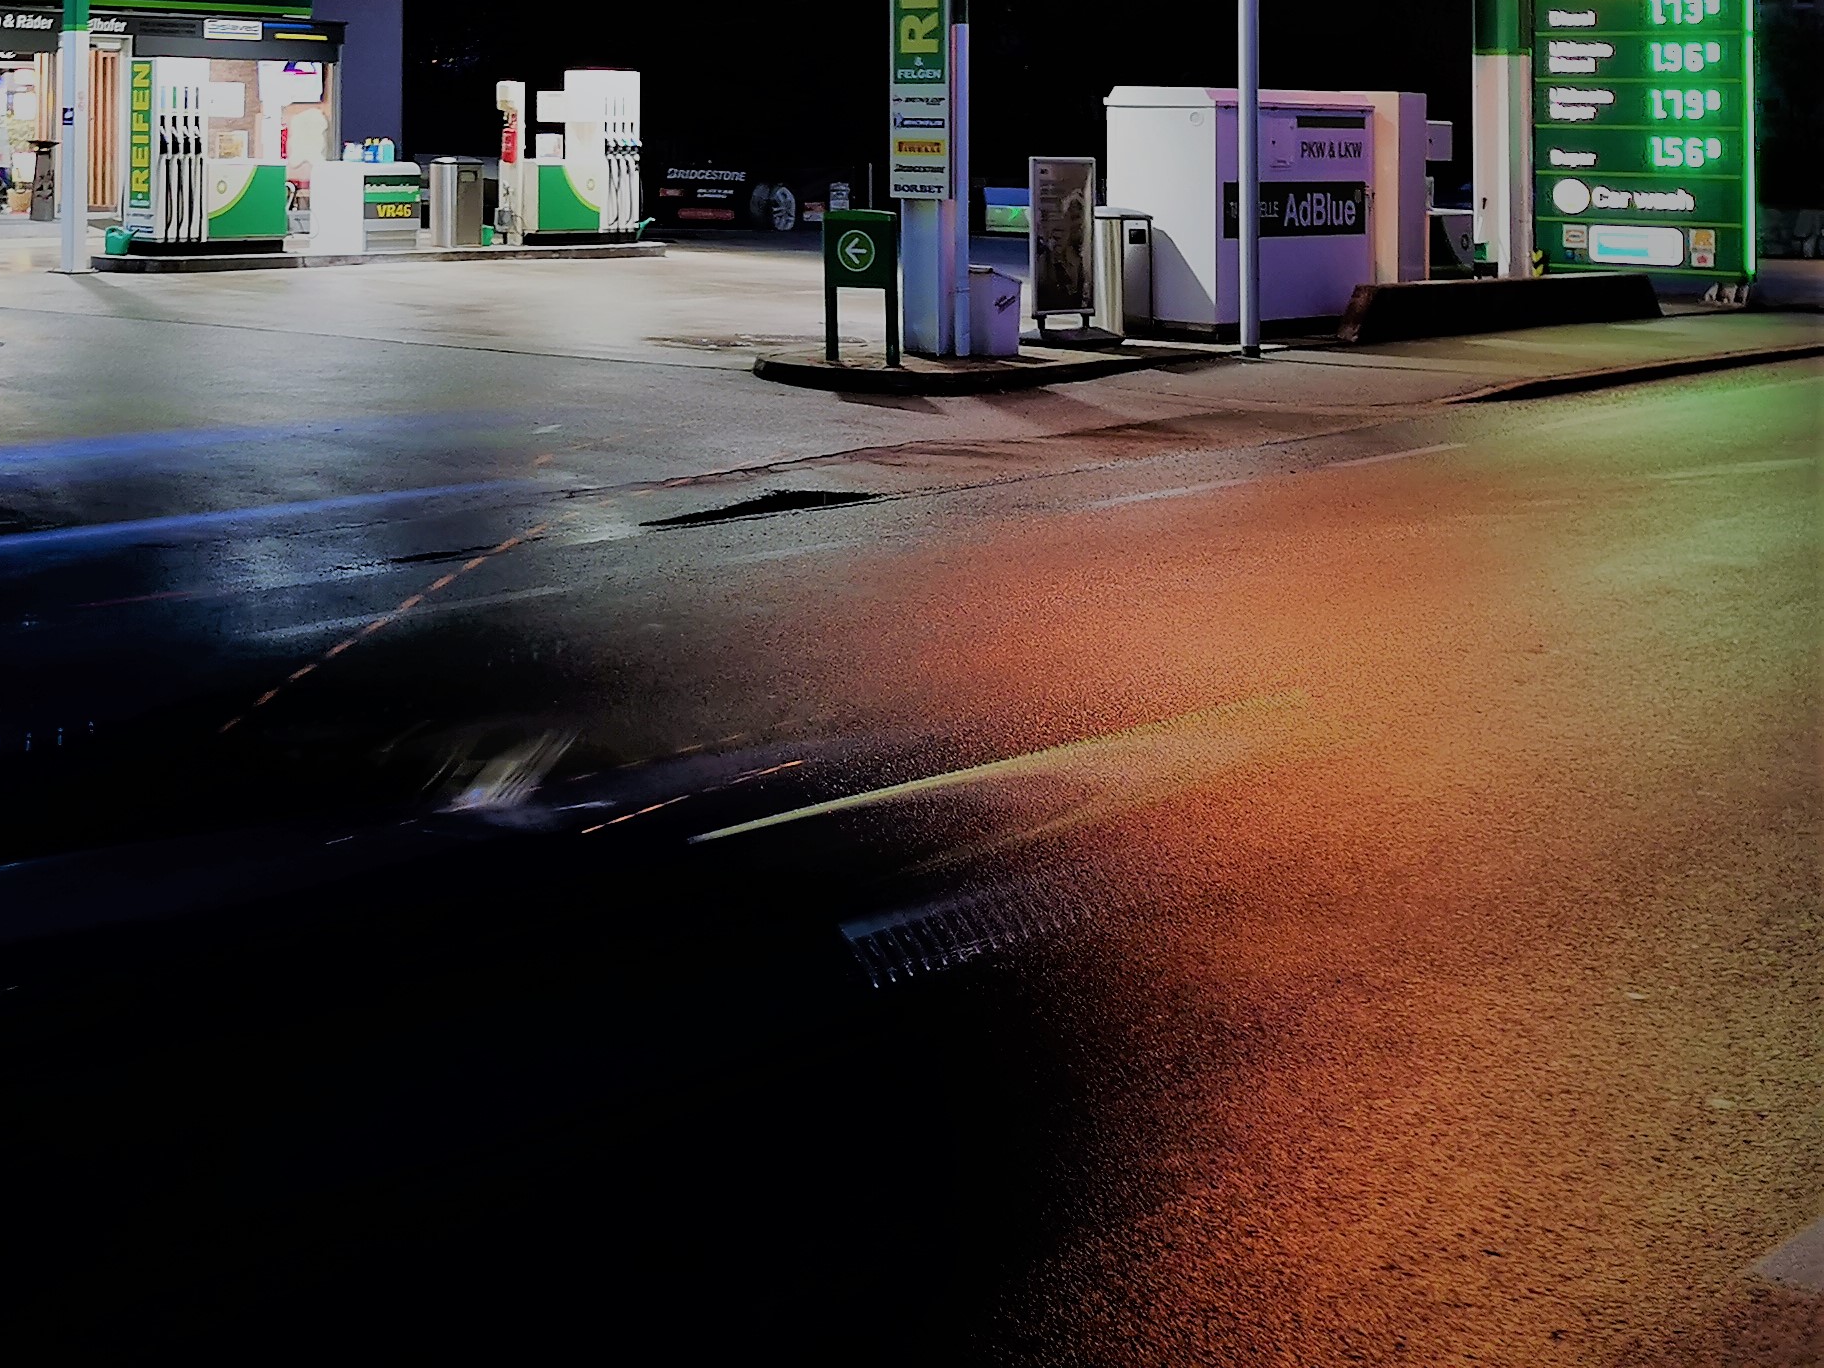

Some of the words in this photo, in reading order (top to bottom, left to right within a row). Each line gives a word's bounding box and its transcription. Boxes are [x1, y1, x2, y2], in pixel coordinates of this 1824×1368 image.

[3, 13, 15, 28] &
[16, 14, 54, 30] Räder
[897, 68, 942, 80] FELGEN
[132, 63, 152, 193] REIFEN
[1300, 141, 1326, 159] PKW
[1328, 141, 1336, 159] &
[1338, 141, 1363, 159] LKW
[666, 167, 747, 182] BRIDGESTONE
[894, 184, 945, 194] BORBET
[376, 204, 413, 218] VR46
[1283, 192, 1357, 228] AdBlue
